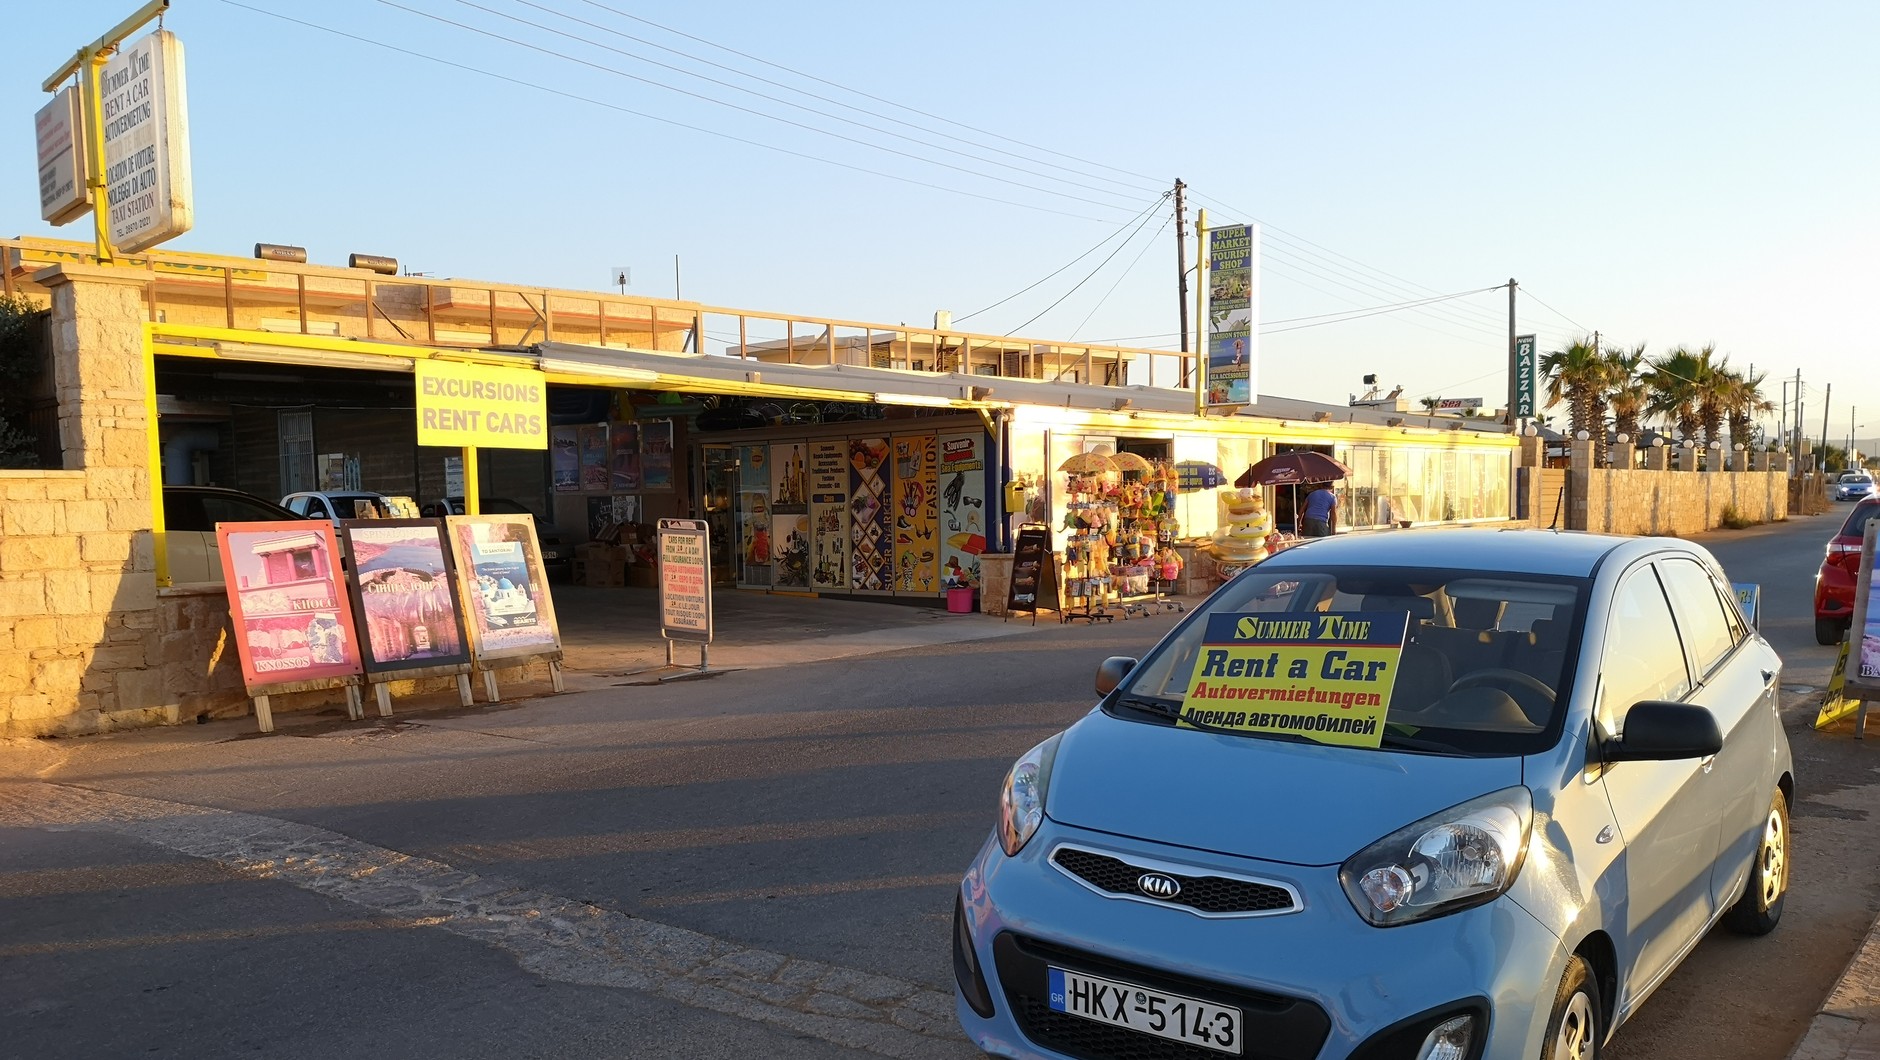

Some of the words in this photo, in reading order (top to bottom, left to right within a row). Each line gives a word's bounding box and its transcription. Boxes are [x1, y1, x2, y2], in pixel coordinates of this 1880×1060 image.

[105, 93, 124, 121] RENT
[126, 88, 132, 106] A
[132, 78, 149, 102] CAR
[105, 100, 150, 144] AUTOVERMIETUNG
[106, 159, 128, 186] LOCATION
[127, 156, 134, 177] DE
[134, 144, 155, 173] VOITURE
[108, 180, 131, 208] NOLEGGI
[131, 177, 139, 198] DI
[139, 167, 156, 192] AUTO
[111, 204, 126, 225] TAXI
[127, 192, 154, 218] STATION
[1216, 227, 1246, 240] SUPER
[1212, 237, 1250, 250] MARKET
[1212, 249, 1250, 261] TOURIST
[1219, 259, 1243, 270] SHOP
[1210, 332, 1232, 340] FASHION
[1233, 330, 1250, 338] STORE
[1219, 371, 1249, 379] ACCESSORIES
[1520, 343, 1531, 415] BAZZAR
[423, 375, 540, 403] EXCURSIONS
[423, 407, 480, 432] RENT
[486, 411, 541, 435] CARS
[946, 440, 970, 452] Souvenir
[925, 436, 938, 520] FASHION
[882, 491, 892, 544] MARKET
[668, 535, 677, 544] CARS
[677, 536, 685, 544] FOR
[686, 537, 696, 545] RENT
[666, 545, 675, 553] FROM
[663, 554, 671, 562] FULL
[671, 555, 691, 565] INSURANCE
[692, 557, 704, 566] 100%
[884, 548, 893, 592] SUPER
[665, 593, 684, 601] LOCATION
[685, 594, 704, 603] VOITURE
[665, 608, 676, 616] TOUT
[676, 610, 691, 619] RISQUE
[689, 603, 700, 611] JOUR
[673, 617, 698, 626] ASSURANCE
[1234, 616, 1312, 640] SUMMER
[1317, 615, 1371, 640] TIME
[256, 656, 310, 672] KNOSSOS
[1201, 650, 1279, 678] Rent
[1287, 659, 1307, 679] a
[1320, 650, 1387, 681] Car
[1192, 682, 1381, 709] Autovermietungen
[1183, 707, 1246, 727] Аренда
[1248, 711, 1377, 735] автомобилей
[1143, 876, 1173, 895] KIA
[1051, 992, 1064, 1005] GR
